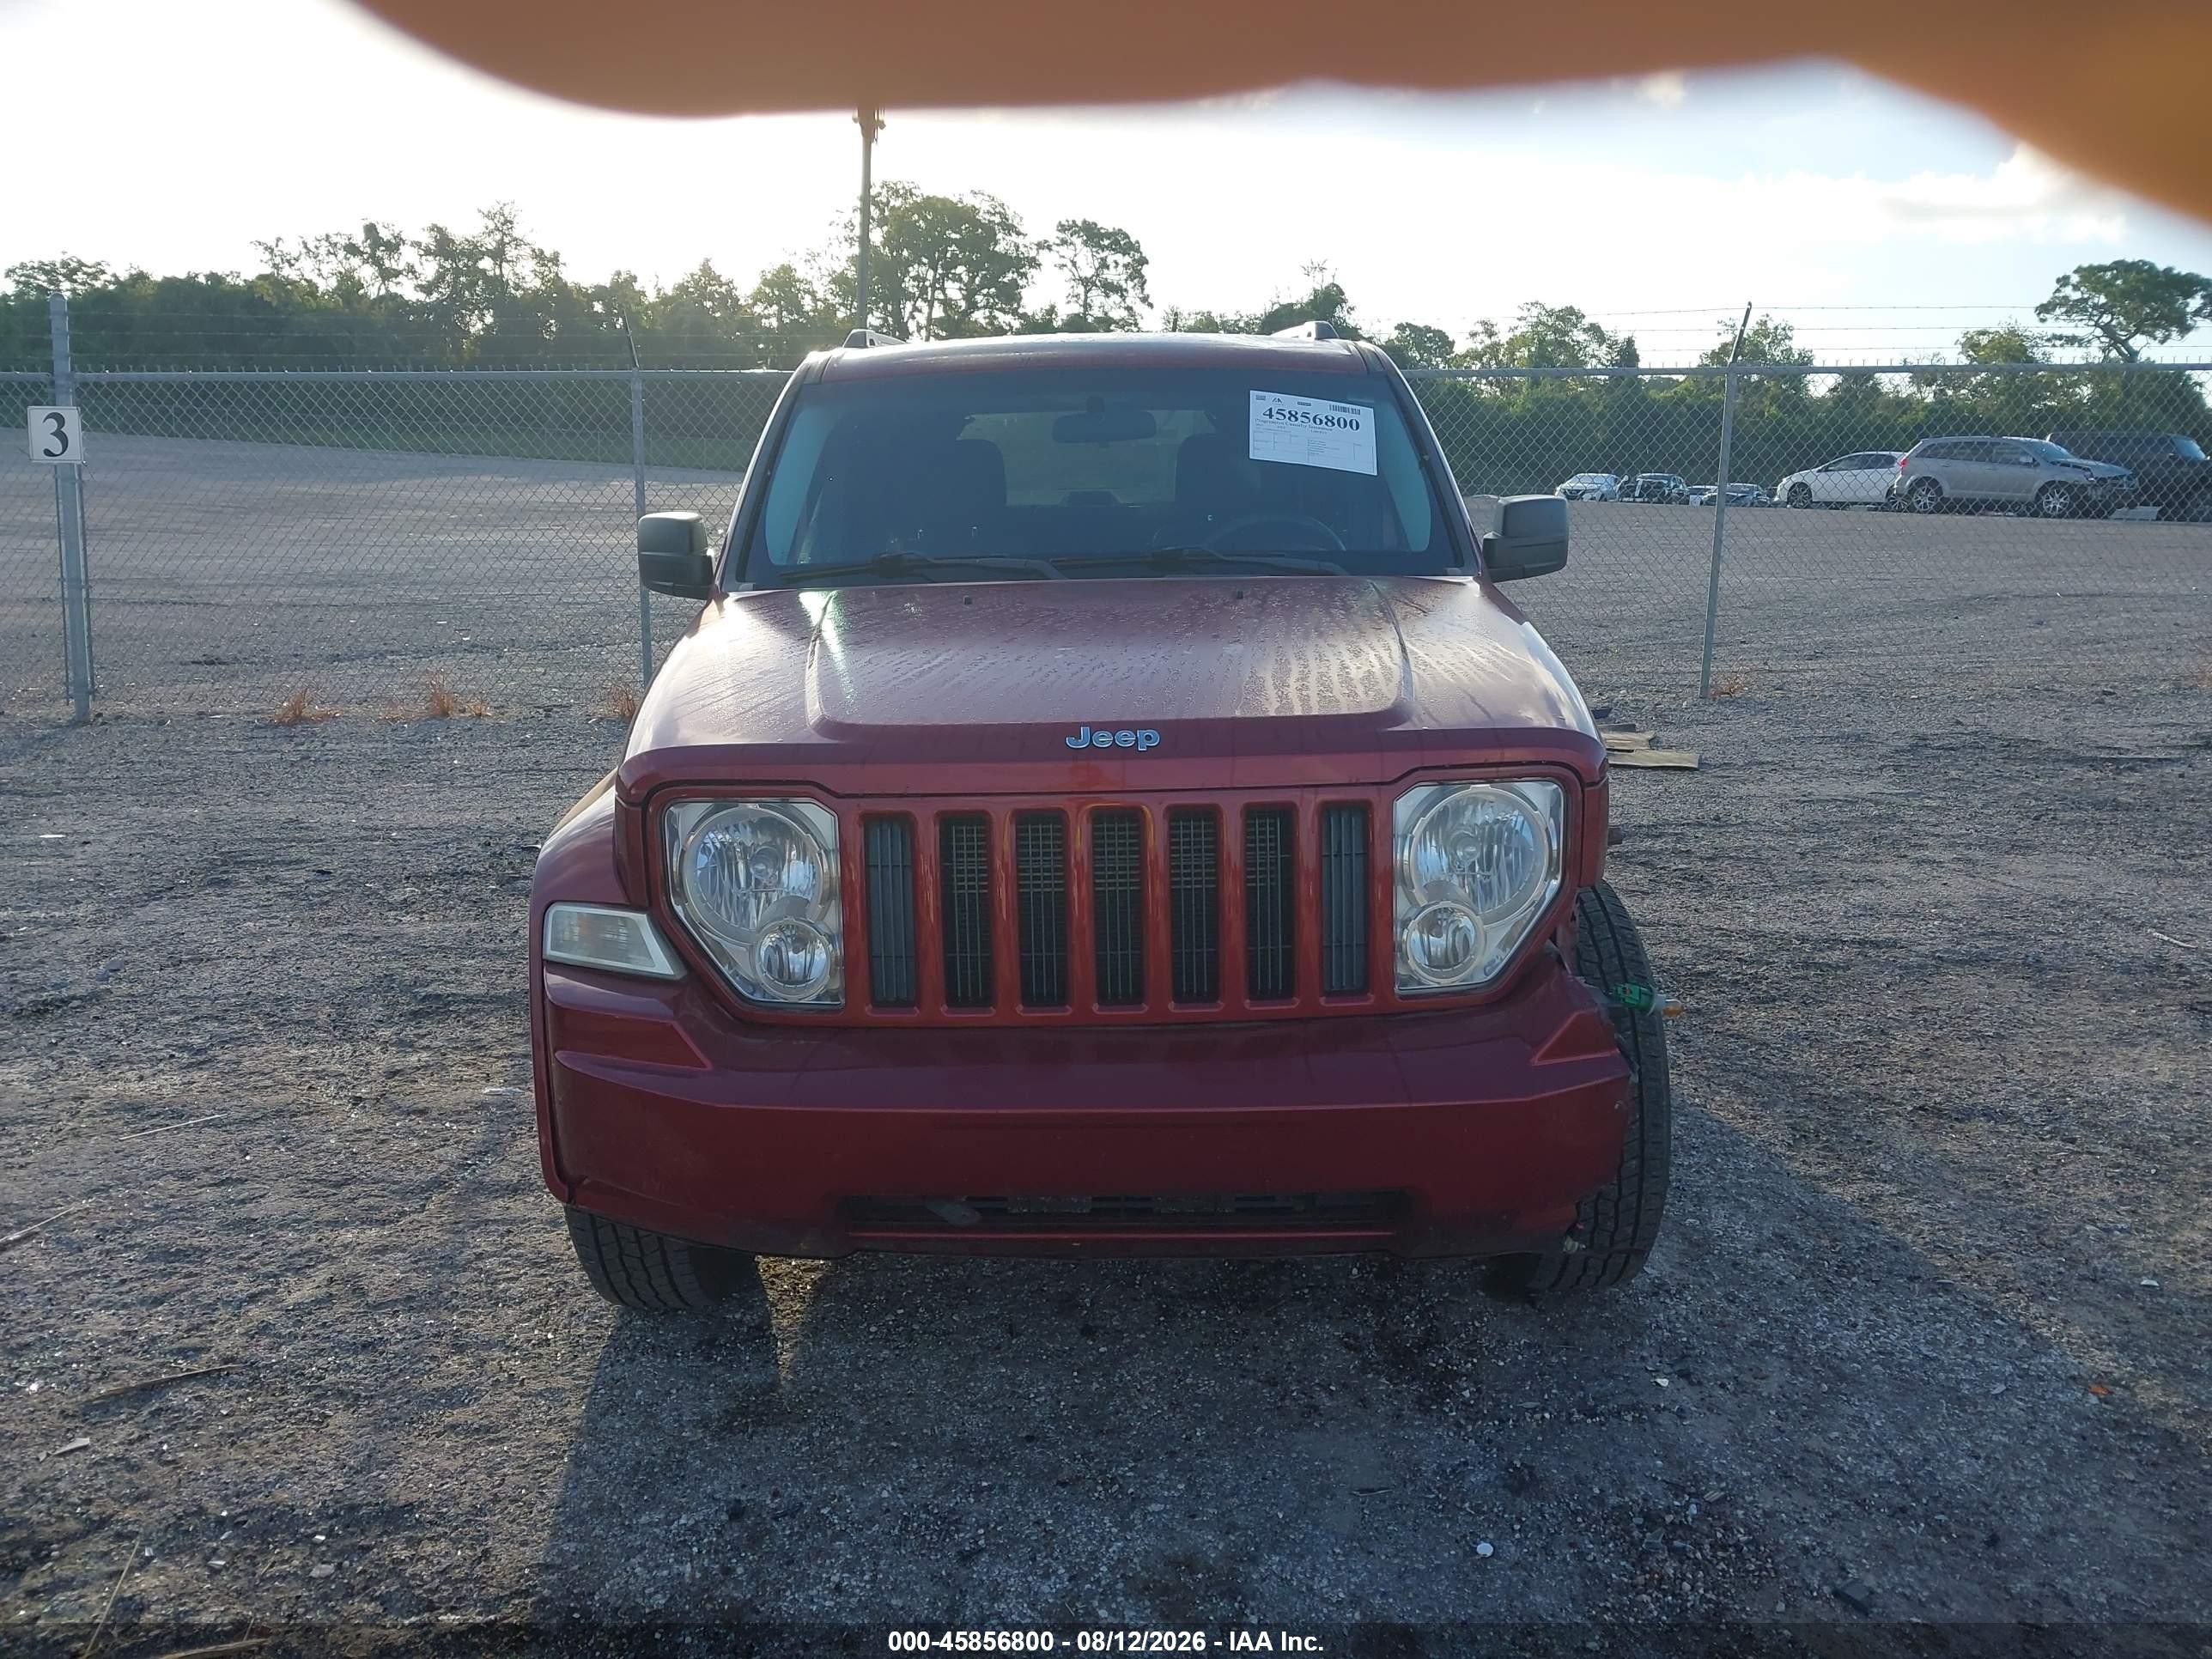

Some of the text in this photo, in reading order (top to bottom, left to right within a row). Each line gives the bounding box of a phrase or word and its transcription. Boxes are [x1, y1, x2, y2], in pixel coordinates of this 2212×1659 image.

[1262, 406, 1360, 431] 45856800
[42, 412, 69, 457] 3
[1066, 726, 1160, 751] Jeep
